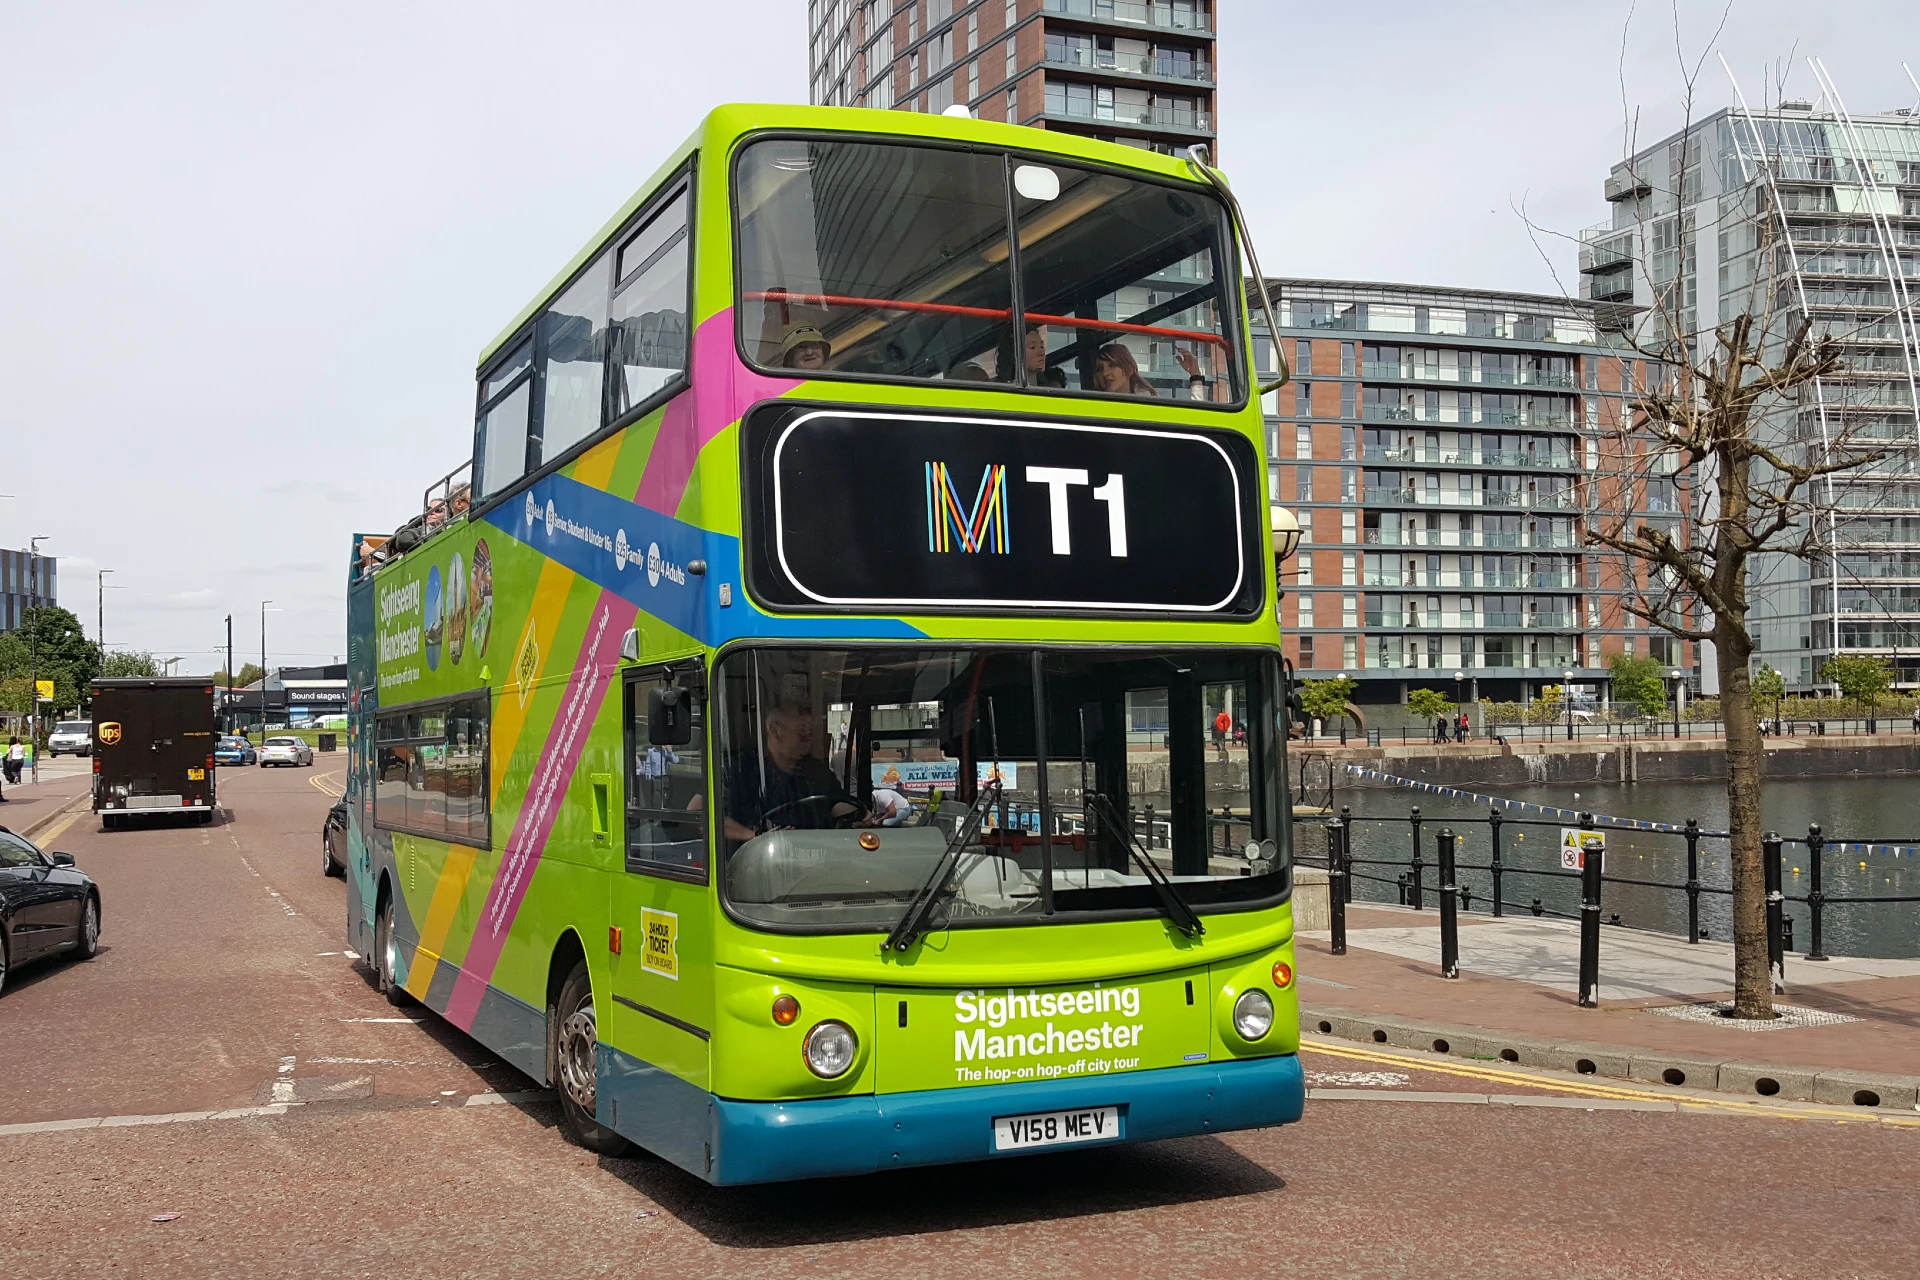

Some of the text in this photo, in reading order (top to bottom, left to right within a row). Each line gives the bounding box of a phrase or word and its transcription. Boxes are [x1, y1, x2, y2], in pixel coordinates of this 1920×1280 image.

[534, 504, 544, 521] Adult
[924, 461, 1128, 557] M T1
[554, 513, 568, 534] Senior,
[567, 518, 585, 540] Student
[584, 526, 589, 542] &
[588, 527, 604, 548] Under
[604, 535, 613, 553] 16s
[616, 540, 644, 571] £25 Family
[648, 555, 685, 586] £30 4 Adults
[380, 573, 420, 628] Sightseeing
[380, 622, 420, 664] Manchester
[291, 692, 315, 700] Sound
[316, 692, 340, 701] stages
[537, 758, 551, 797] Football
[550, 724, 566, 768] Museum
[567, 658, 591, 722] Manchester
[588, 630, 601, 662] Town
[599, 604, 610, 636] Hall
[563, 700, 586, 761] Manchester
[584, 662, 599, 704] United
[101, 728, 120, 742] ups
[907, 772, 928, 781] ALL
[649, 922, 669, 938] 24 HOUR
[649, 935, 669, 955] TICKET
[646, 953, 673, 970] BUY ON BOARD
[954, 981, 1140, 1028] Sightseeing
[954, 1021, 1144, 1063] Manchester
[955, 1056, 1140, 1082] The hop-on hop-off city tour
[1009, 1111, 1106, 1144] V158 MEV
